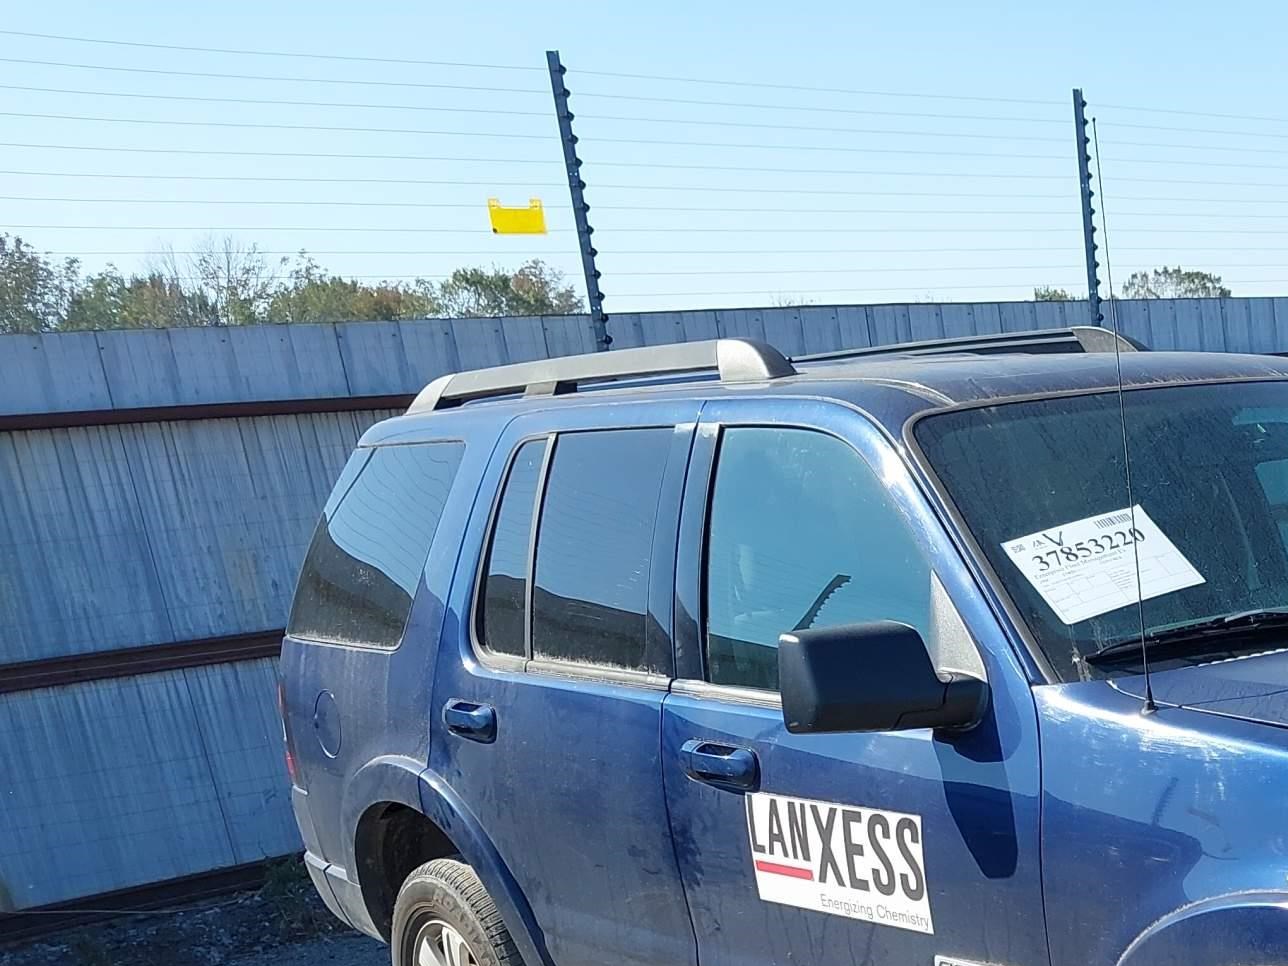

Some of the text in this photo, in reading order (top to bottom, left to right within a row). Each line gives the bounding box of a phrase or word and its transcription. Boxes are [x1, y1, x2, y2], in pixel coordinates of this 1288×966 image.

[1032, 527, 1145, 571] 37853220
[748, 797, 926, 902] LANXESS
[820, 893, 930, 931] Energizing Chemistry
